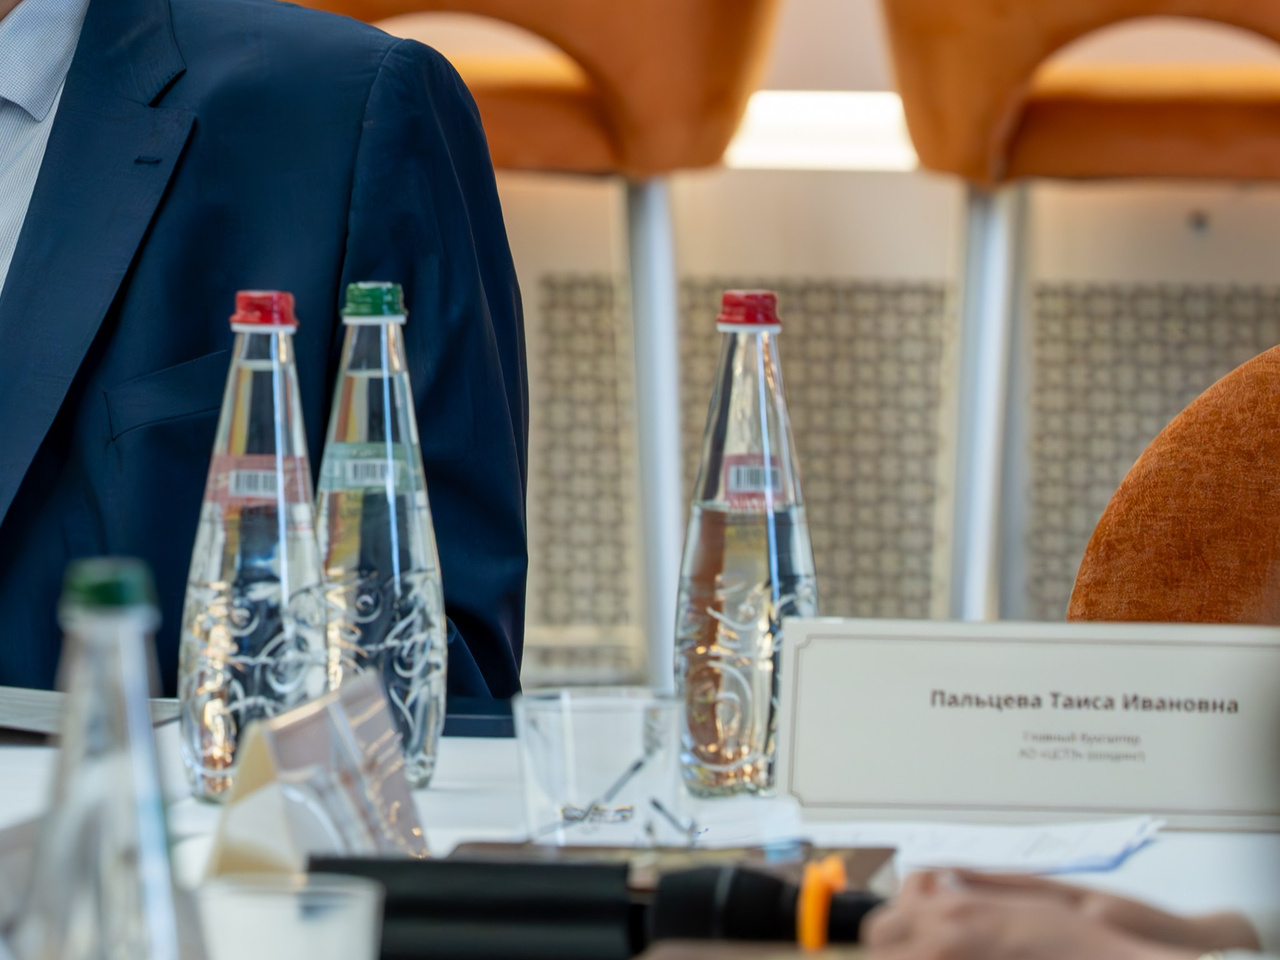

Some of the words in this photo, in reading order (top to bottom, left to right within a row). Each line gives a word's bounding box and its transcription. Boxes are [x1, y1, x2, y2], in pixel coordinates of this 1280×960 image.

[930, 689, 1042, 713] Пальцева
[1049, 691, 1115, 711] Таиса
[1123, 692, 1239, 715] Ивановна
